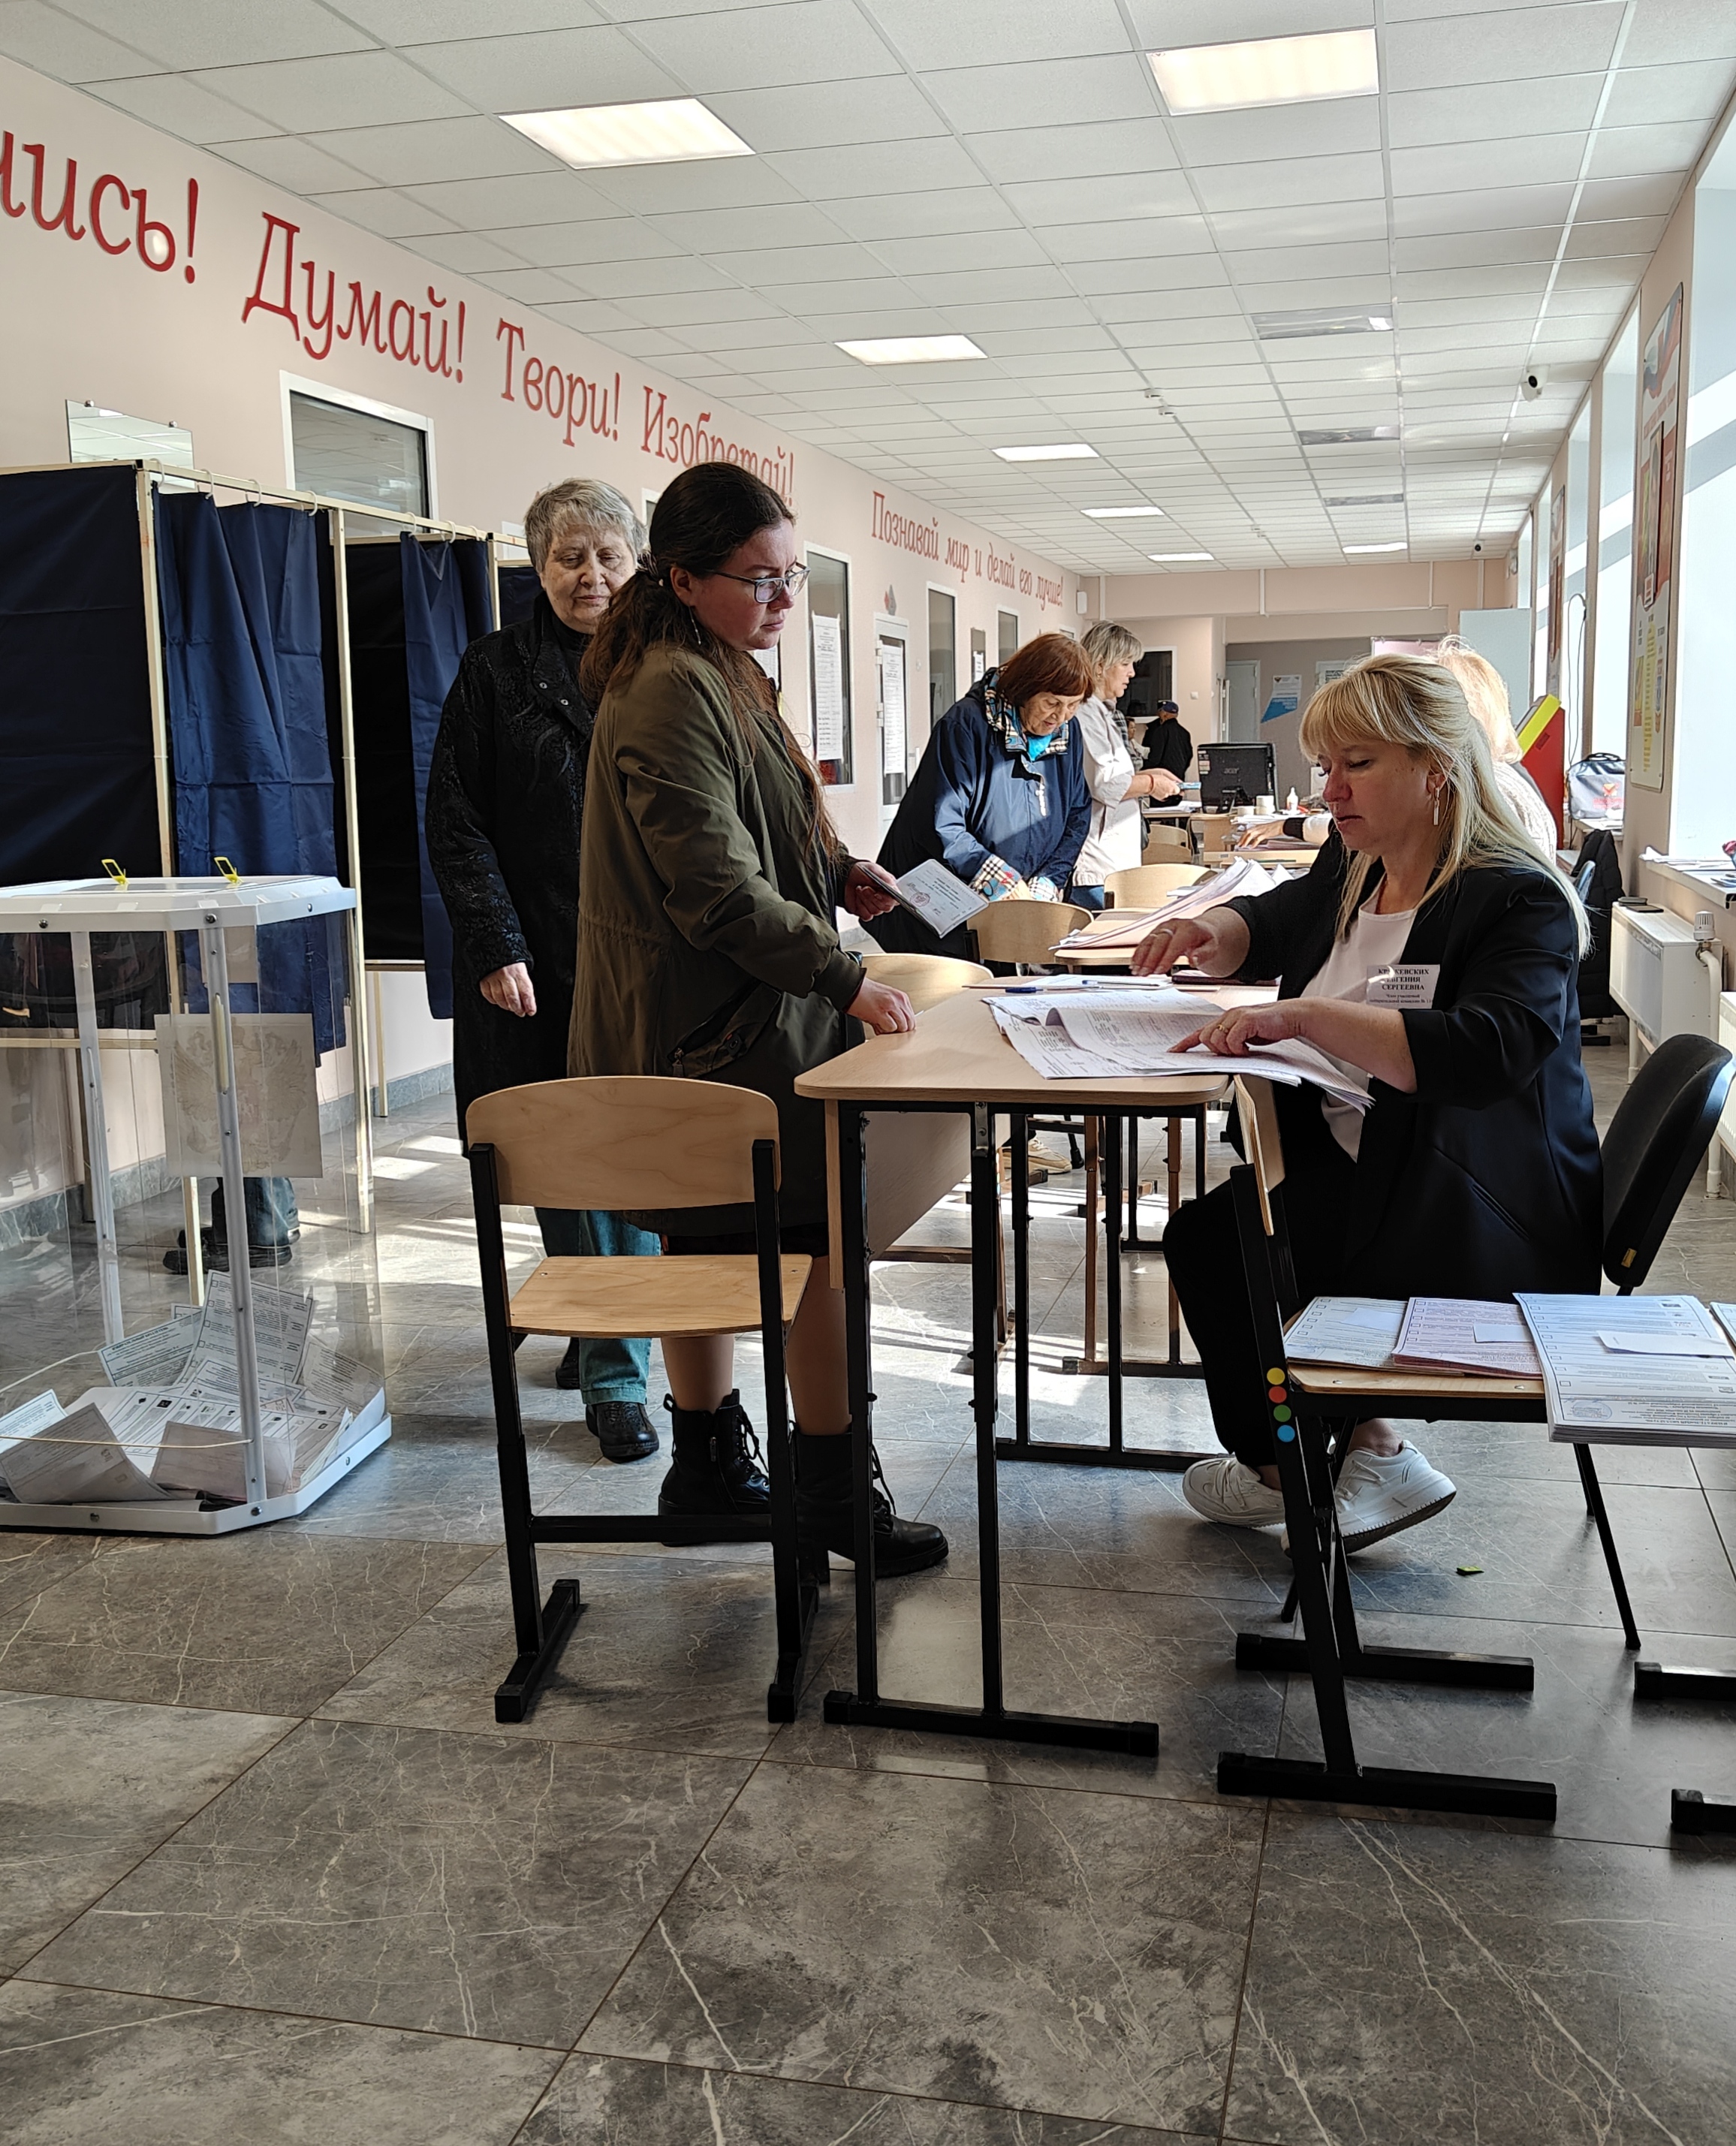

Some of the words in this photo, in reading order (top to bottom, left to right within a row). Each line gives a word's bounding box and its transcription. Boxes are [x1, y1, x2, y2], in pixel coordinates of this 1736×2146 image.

[241, 211, 466, 384] Думай!
[496, 318, 621, 448] Твори!
[871, 490, 939, 562] Познавай
[944, 537, 970, 583] мир
[975, 549, 983, 578] и
[987, 541, 1016, 590] делай
[1019, 568, 1033, 596] его
[1035, 575, 1064, 611] лучше!
